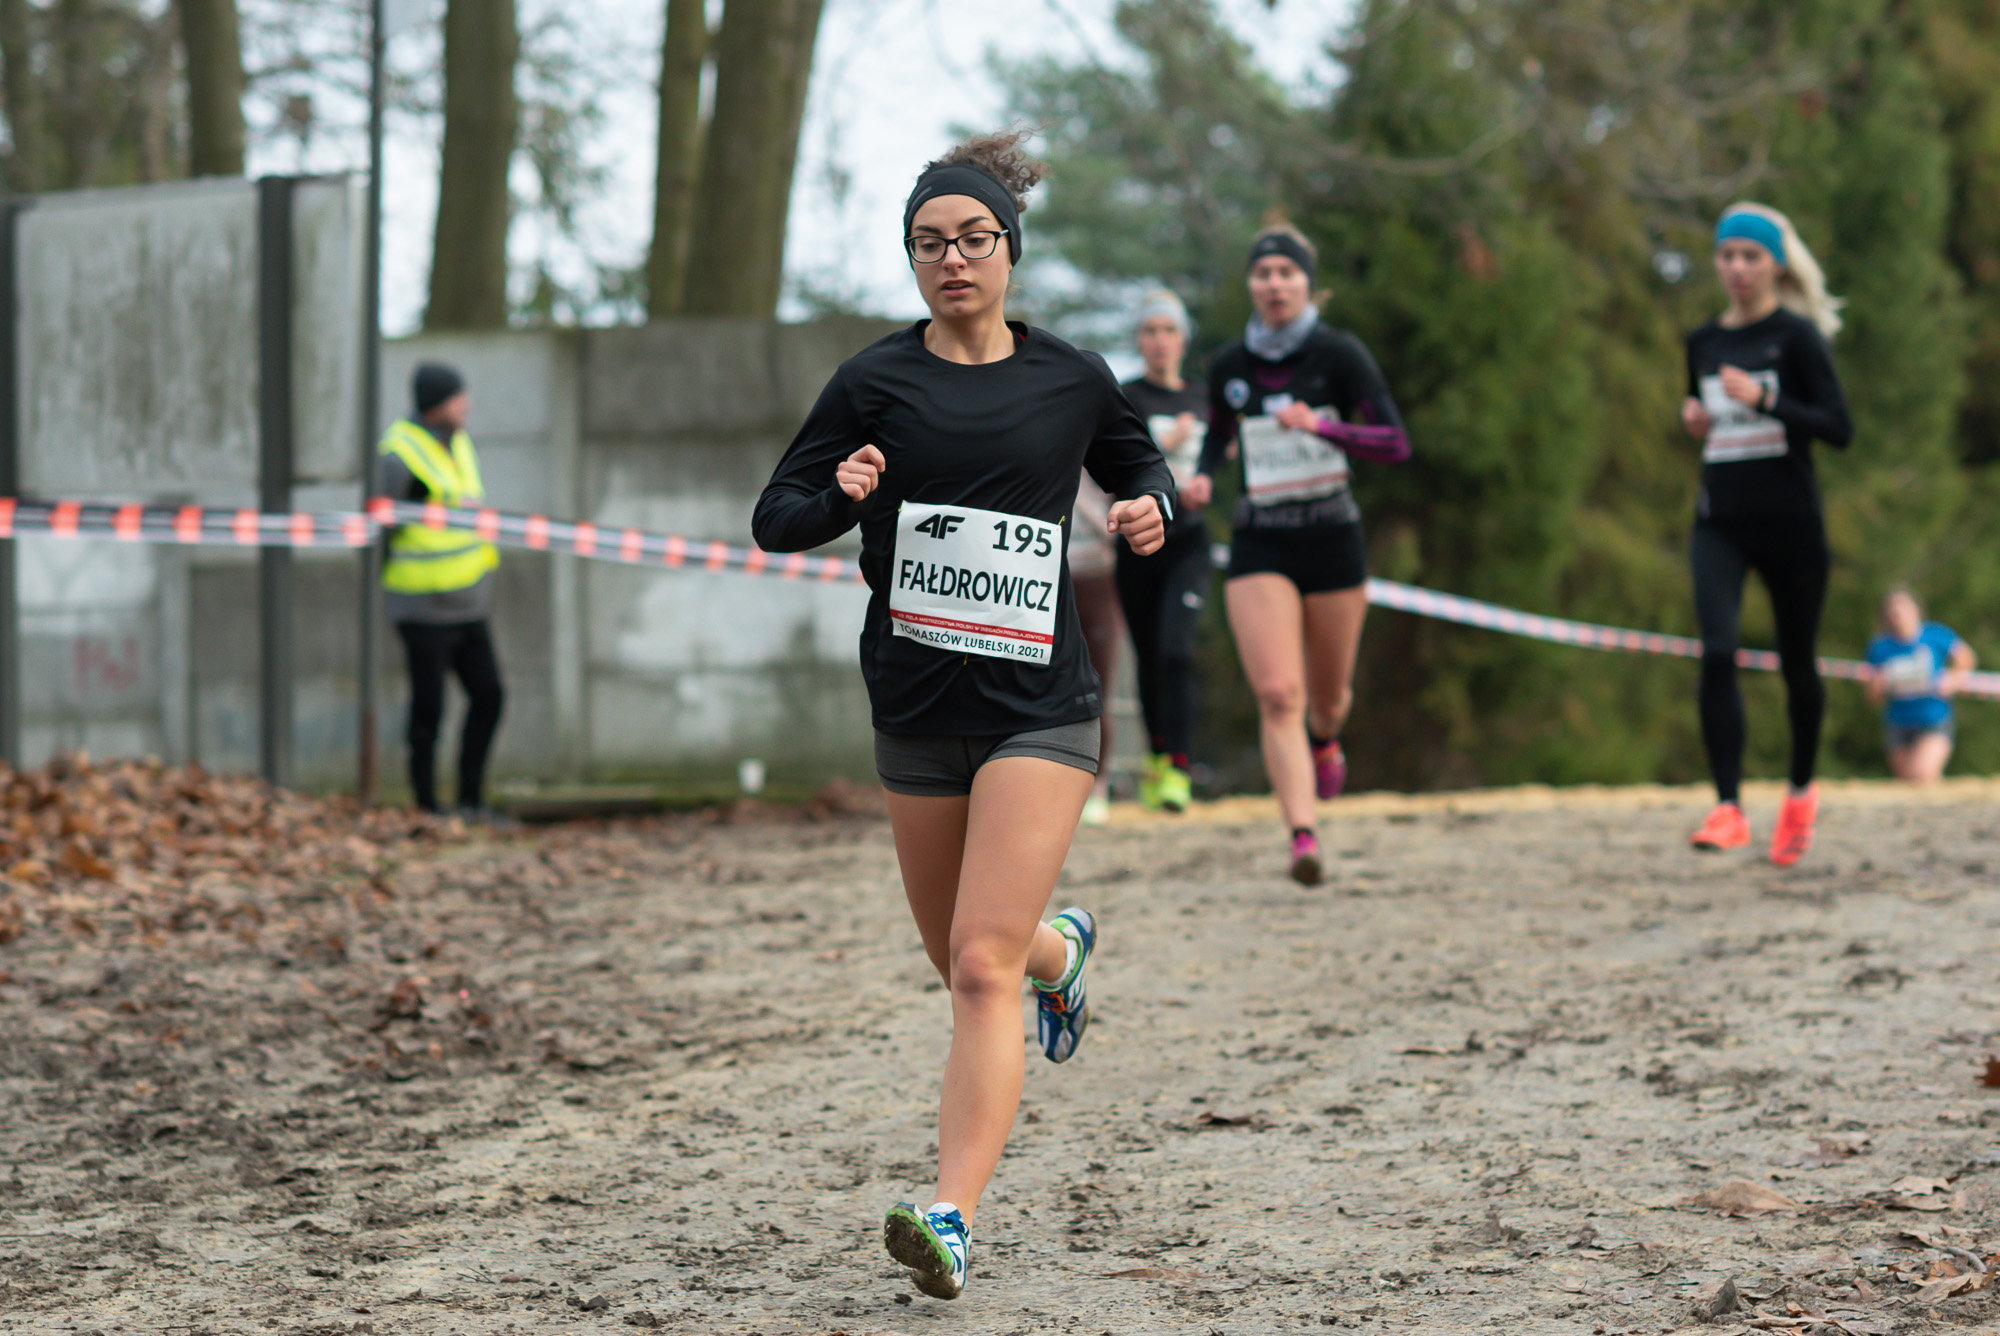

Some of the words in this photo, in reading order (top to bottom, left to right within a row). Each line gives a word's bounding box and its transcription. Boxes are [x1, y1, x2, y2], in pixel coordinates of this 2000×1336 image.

[914, 513, 966, 540] 4F
[992, 520, 1052, 558] 195
[898, 558, 1053, 612] FAŁDROWICZ
[899, 623, 962, 647] TOMASZÓW
[964, 634, 1015, 654] LUBELSKI
[1017, 645, 1044, 659] 2021
